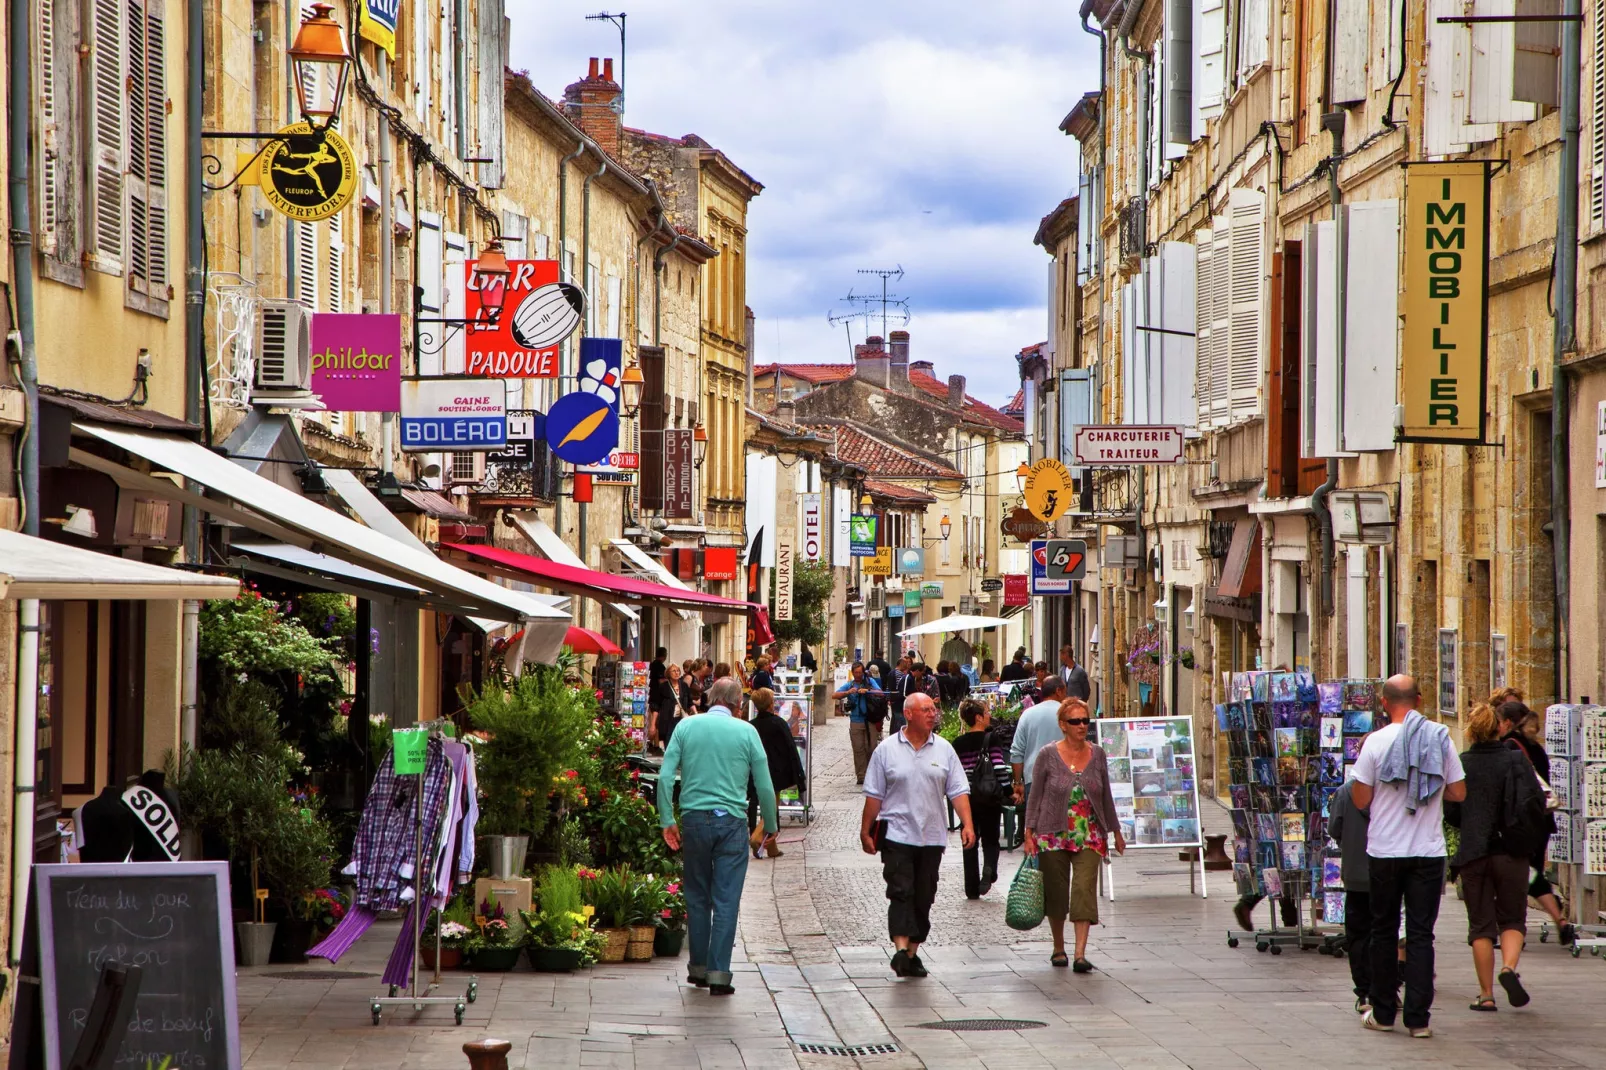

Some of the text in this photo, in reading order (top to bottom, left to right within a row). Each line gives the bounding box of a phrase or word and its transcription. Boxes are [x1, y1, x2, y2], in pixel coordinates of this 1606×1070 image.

[325, 132, 343, 151] ONDE
[342, 151, 351, 180] ENTIER
[268, 189, 346, 217] INTERFLORA
[285, 187, 314, 195] FLEUROP
[1425, 178, 1466, 426] IMMOBILIER
[311, 347, 393, 375] phildar
[468, 350, 554, 375] PADOUE
[453, 396, 491, 406] GAINE
[405, 419, 502, 442] BOLÉRO
[1088, 431, 1171, 442] CHARCUTERIE
[1099, 449, 1159, 459] TRAITEUR
[665, 431, 676, 517] BOULANGERIE
[680, 431, 690, 510] PATISSERIE
[1025, 459, 1072, 491] IMMOBILIER
[706, 571, 733, 580] orange
[778, 542, 790, 620] RESTAURANT
[864, 565, 890, 574] VOYAGES
